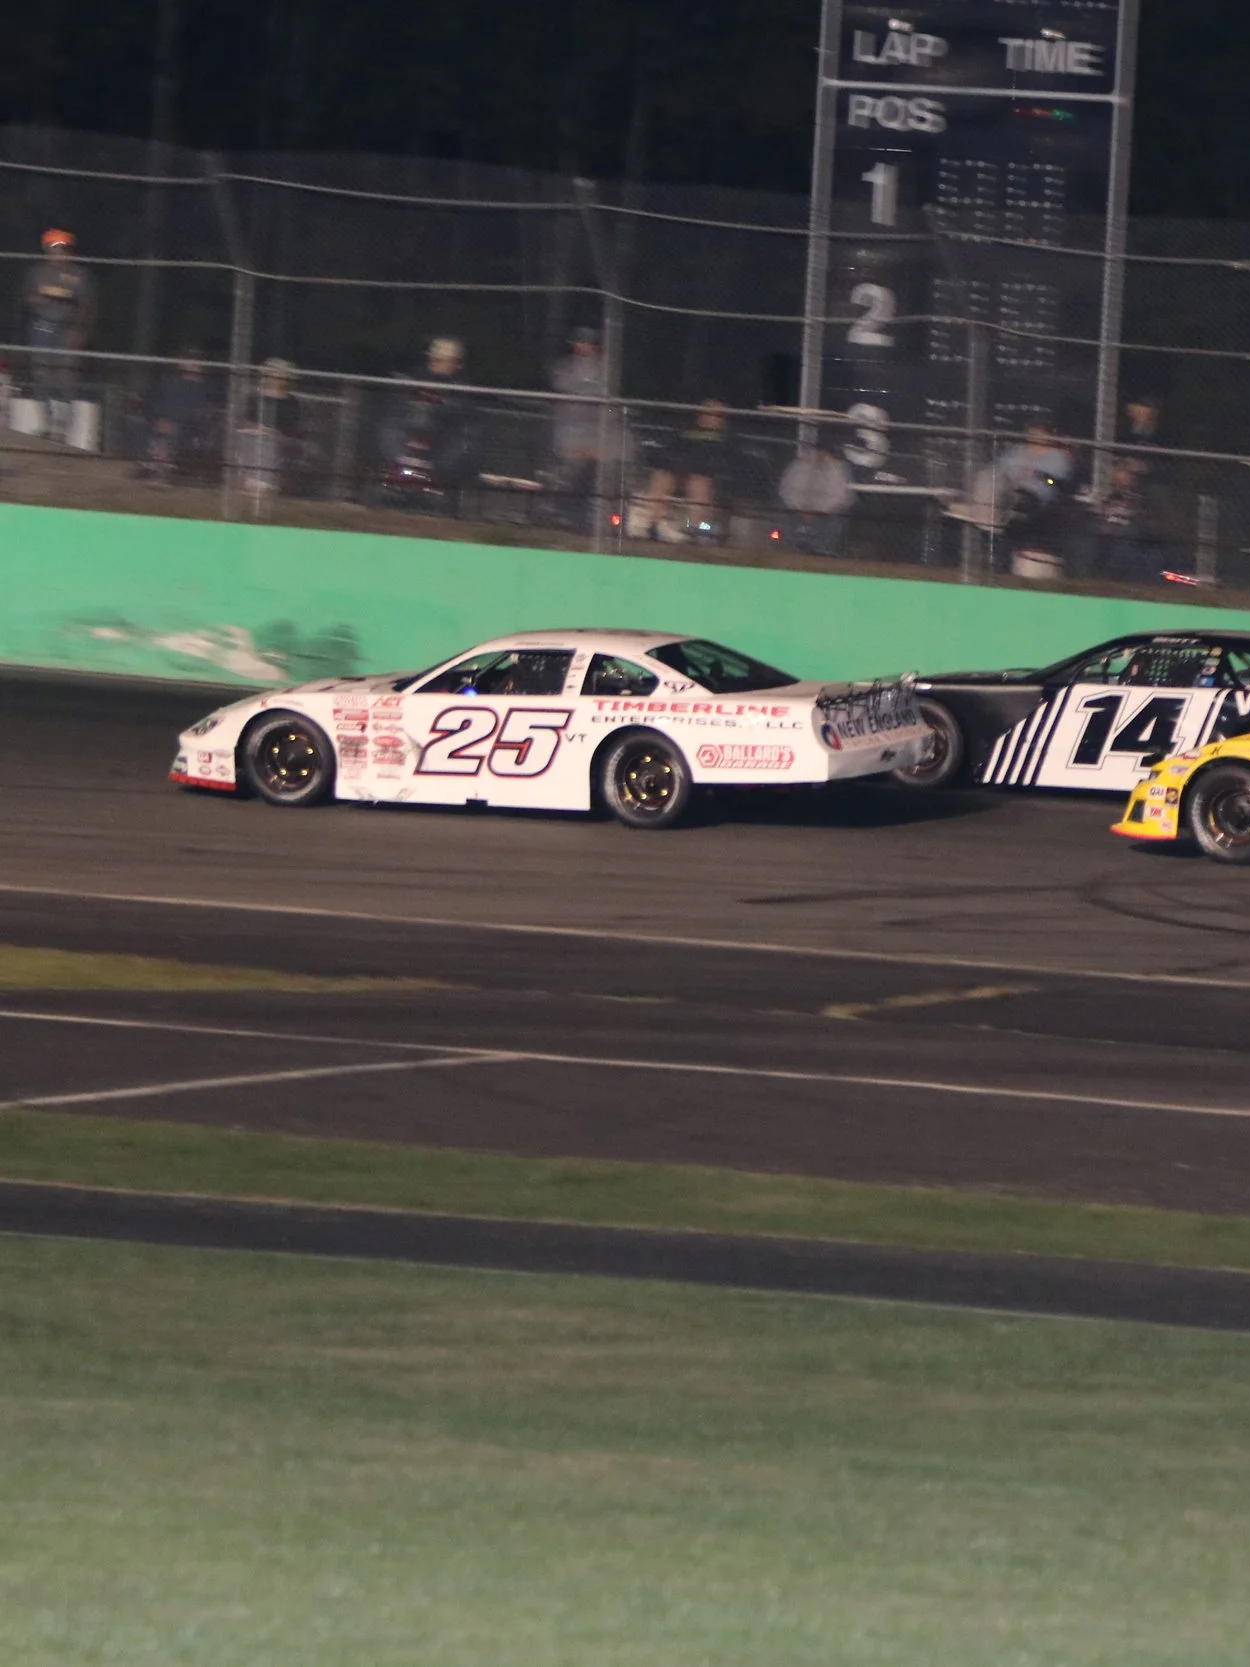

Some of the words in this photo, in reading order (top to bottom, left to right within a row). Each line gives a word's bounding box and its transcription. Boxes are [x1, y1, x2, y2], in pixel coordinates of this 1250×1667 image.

[853, 30, 948, 67] LAP
[998, 37, 1105, 76] TIME
[848, 95, 948, 133] POS
[861, 162, 898, 227] 1
[847, 283, 897, 347] 2
[843, 403, 891, 468] 3
[593, 699, 791, 717] TIMBERLINE
[766, 722, 803, 730] LLC
[1065, 688, 1190, 773] 14
[414, 706, 575, 778] 25
[564, 733, 588, 744] VT
